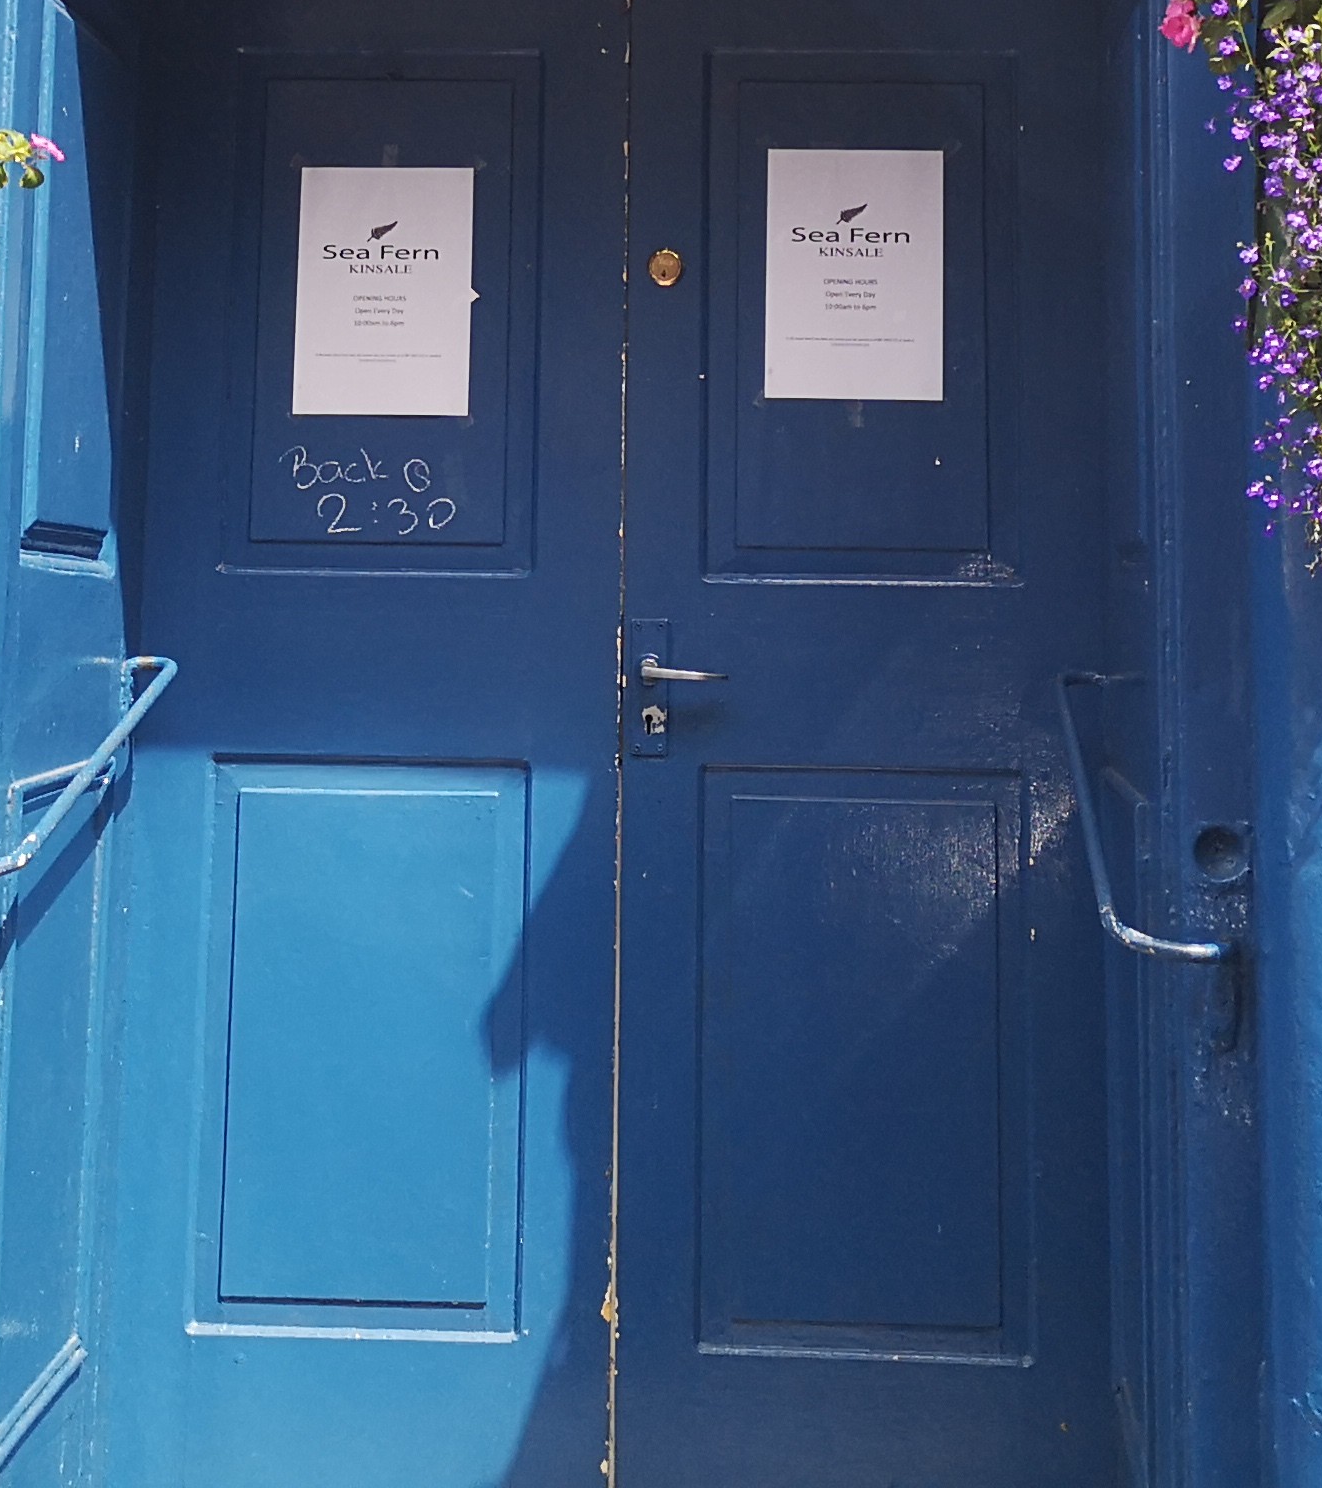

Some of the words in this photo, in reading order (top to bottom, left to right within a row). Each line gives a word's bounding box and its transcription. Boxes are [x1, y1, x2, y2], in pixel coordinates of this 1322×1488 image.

[791, 226, 840, 243] Sea
[850, 227, 911, 244] Fern
[322, 244, 370, 260] Sea
[380, 244, 439, 260] Fern
[818, 247, 884, 258] KINSALE
[349, 264, 412, 275] KINSALE
[279, 445, 389, 489] Back
[316, 493, 456, 535] 2:30
